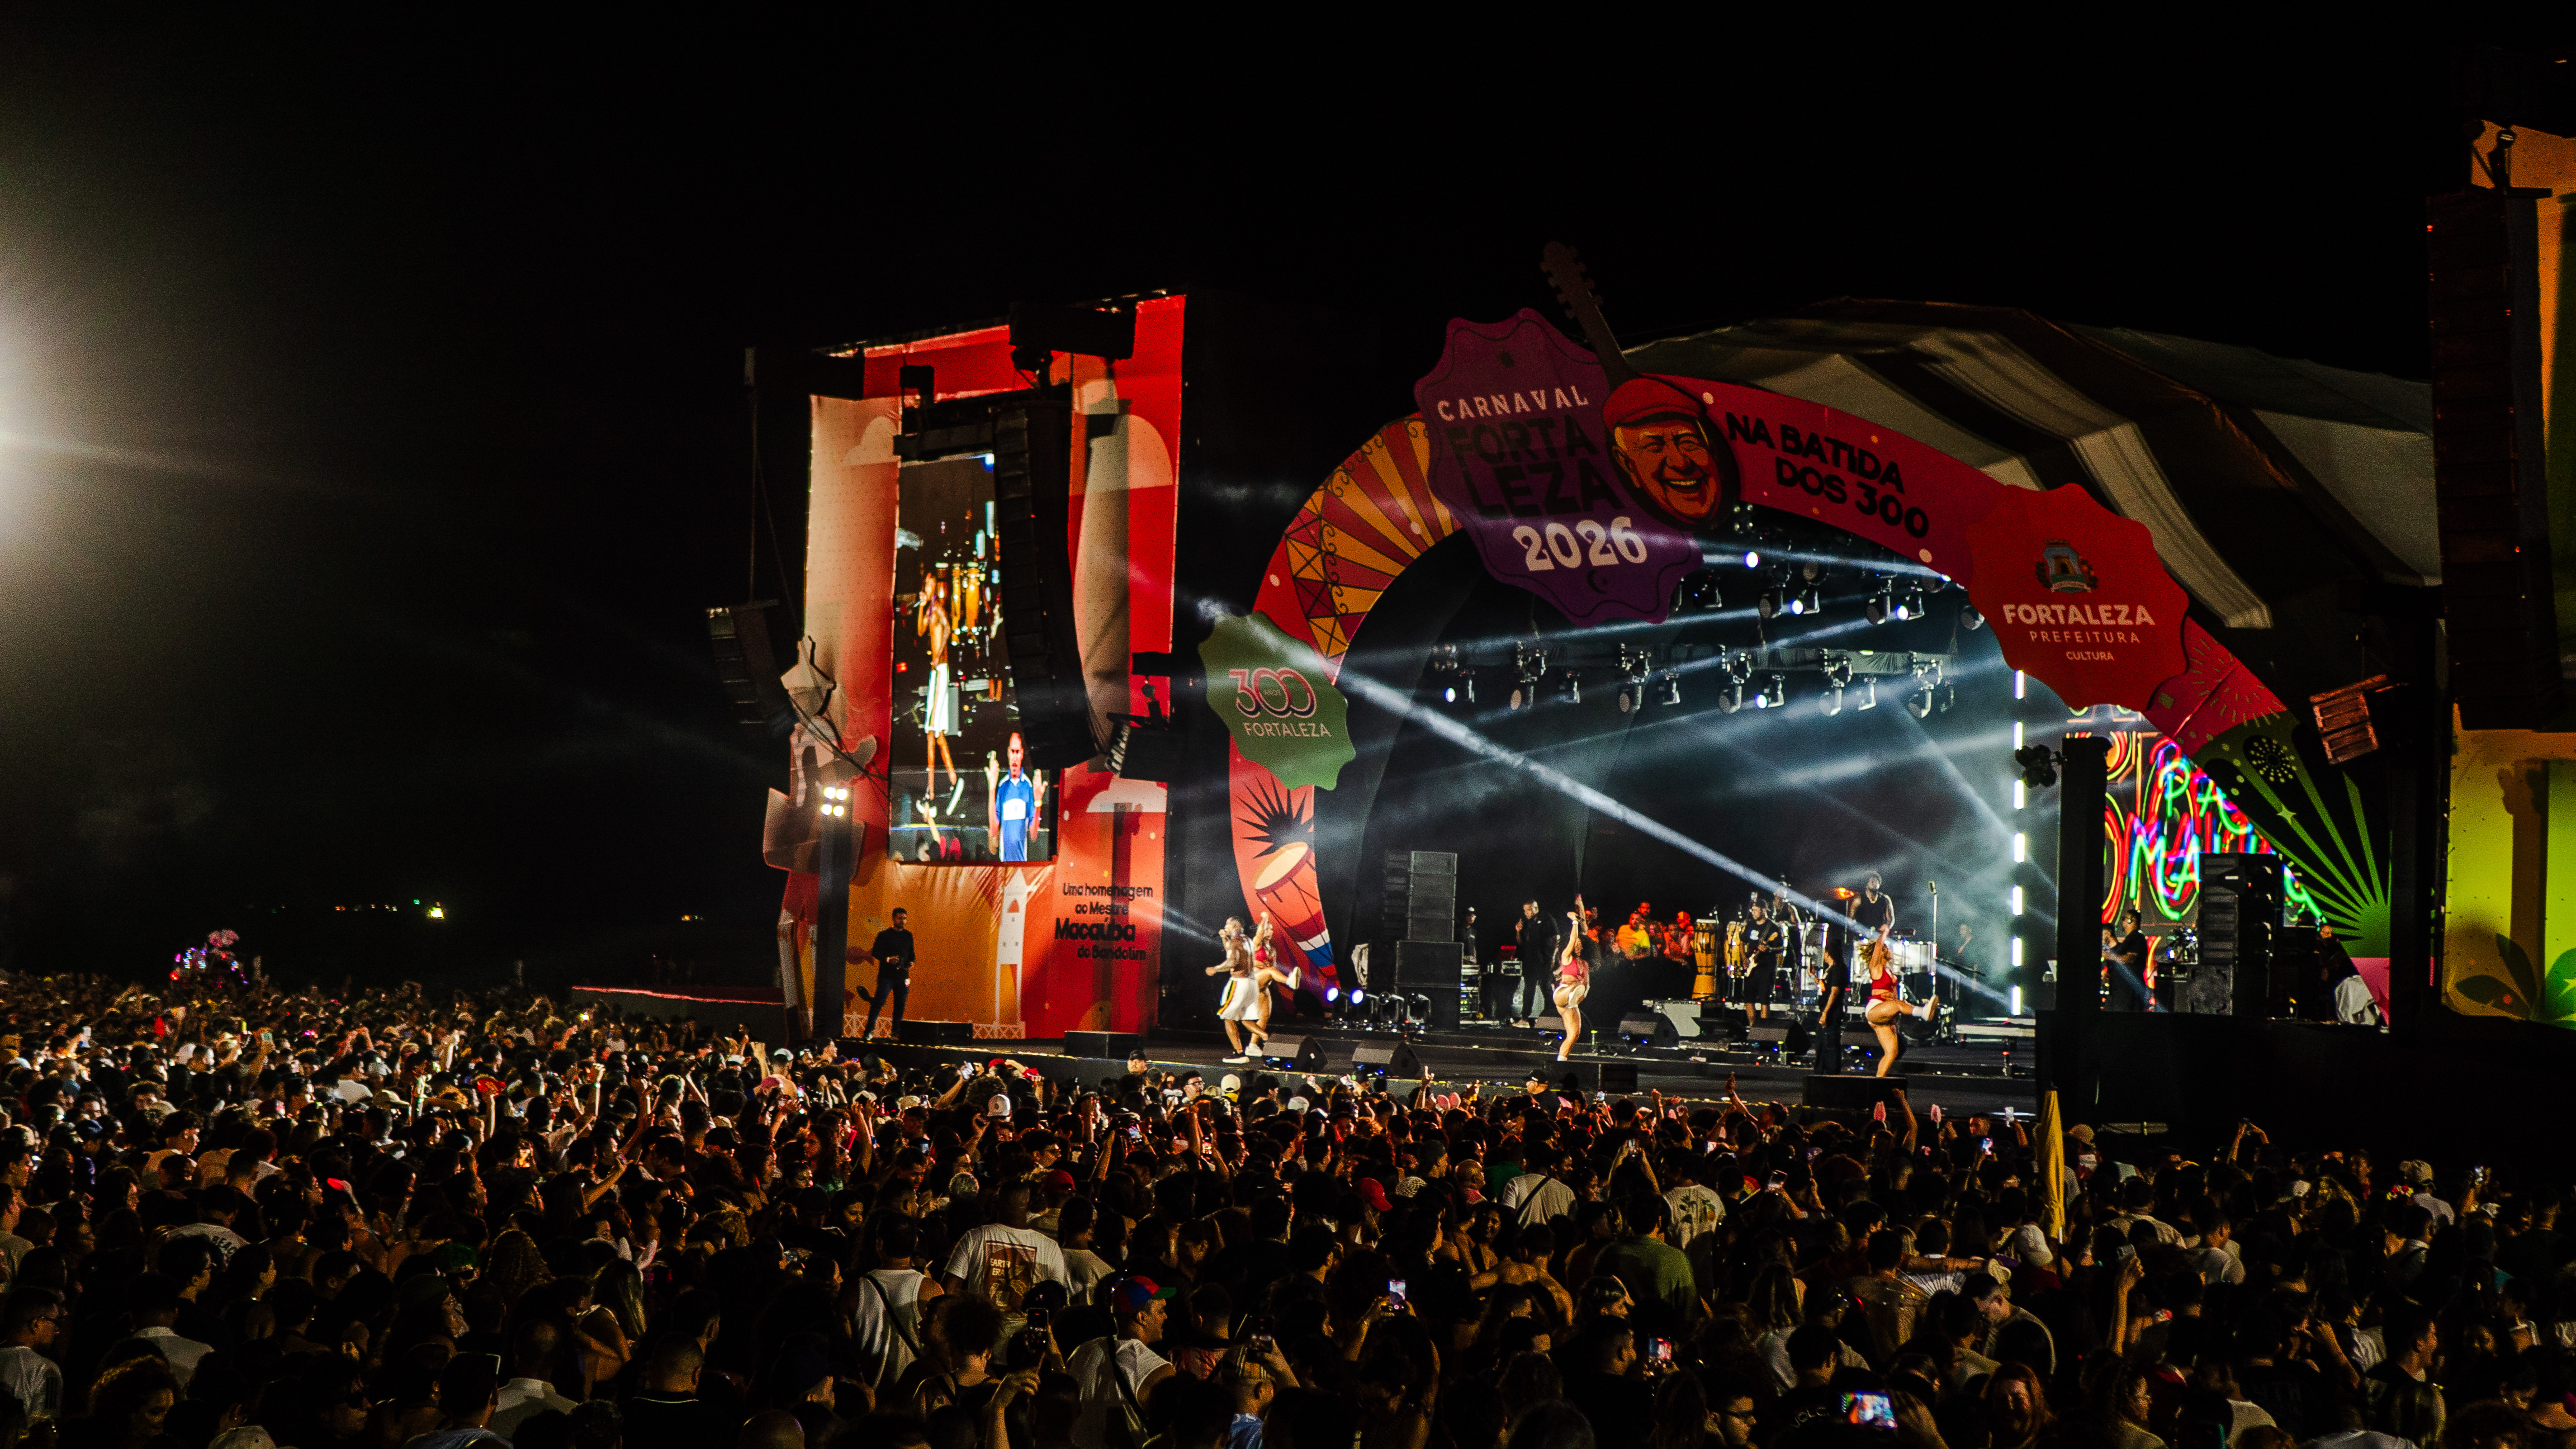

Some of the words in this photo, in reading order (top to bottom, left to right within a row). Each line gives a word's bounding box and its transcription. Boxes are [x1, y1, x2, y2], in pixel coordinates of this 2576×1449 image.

[1437, 385, 1589, 422] CARNAVAL
[1445, 415, 1599, 468] FORTA
[1726, 411, 1776, 449] NA
[1780, 423, 1905, 495] BATIDA
[1462, 458, 1626, 520] LEZA
[1775, 457, 1848, 504] DOS
[1855, 480, 1929, 538] 300
[1512, 515, 1647, 571] 2026
[2002, 603, 2156, 626] FORTALEZA
[2029, 630, 2141, 643] PREFEITURA
[2066, 650, 2115, 661] CULTURA
[1229, 667, 1318, 718] 300
[1243, 722, 1332, 737] FORTALEZA
[1063, 882, 1083, 896] Uma
[1085, 883, 1153, 901] homenagem
[1074, 903, 1088, 915] ao
[1090, 901, 1129, 915] Mestre
[1054, 917, 1136, 942] Macaúba
[1077, 944, 1091, 958] do
[1092, 944, 1147, 960] Bandolim
